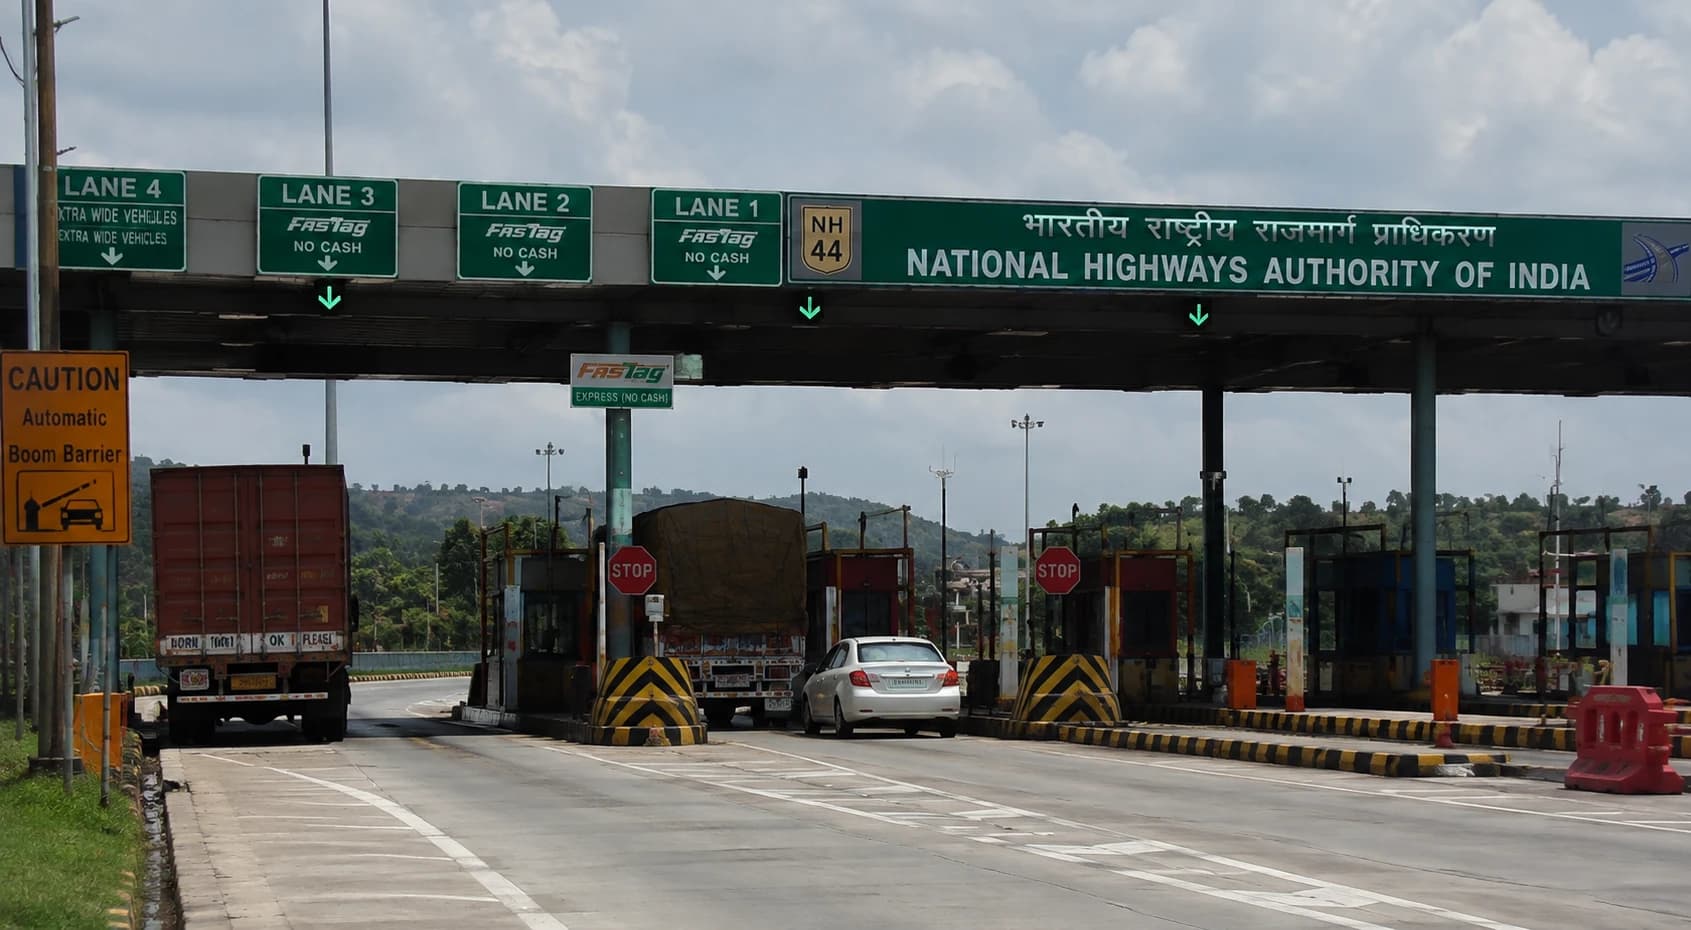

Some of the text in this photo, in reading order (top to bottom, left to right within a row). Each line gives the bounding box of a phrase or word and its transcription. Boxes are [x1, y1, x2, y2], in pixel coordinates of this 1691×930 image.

[64, 176, 161, 199] LANE 4
[282, 184, 375, 206] LANE 3
[481, 191, 570, 212] LANE 2
[676, 197, 758, 217] LANE 1
[58, 207, 87, 221] XTRA
[91, 208, 118, 223] WIDE
[287, 217, 371, 237] FASTag
[485, 223, 566, 242] FASTag
[812, 216, 843, 234] NH
[1023, 208, 1496, 248] भारतीय राष्ट्रीय राजमार्ग प्राधिकरण
[94, 231, 117, 244] WIDE
[122, 232, 167, 245] VEHICLES
[294, 240, 362, 254] NO CASH
[678, 228, 758, 248] FASTag
[494, 246, 557, 259] NO CASH
[685, 251, 749, 264] NO CASH
[811, 240, 843, 262] 44
[907, 248, 1590, 290] NATIONAL HIGHWAYS AUTHORITY OF INDIA
[8, 367, 119, 391] CAUTION
[577, 361, 670, 384] FASTag
[576, 392, 668, 403] EXPRESS (NO CASH)
[23, 408, 107, 426] Automatic
[9, 444, 122, 463] Boom Barrier
[612, 563, 653, 578] STOP
[1038, 564, 1077, 577] STOP
[269, 635, 284, 646] OK
